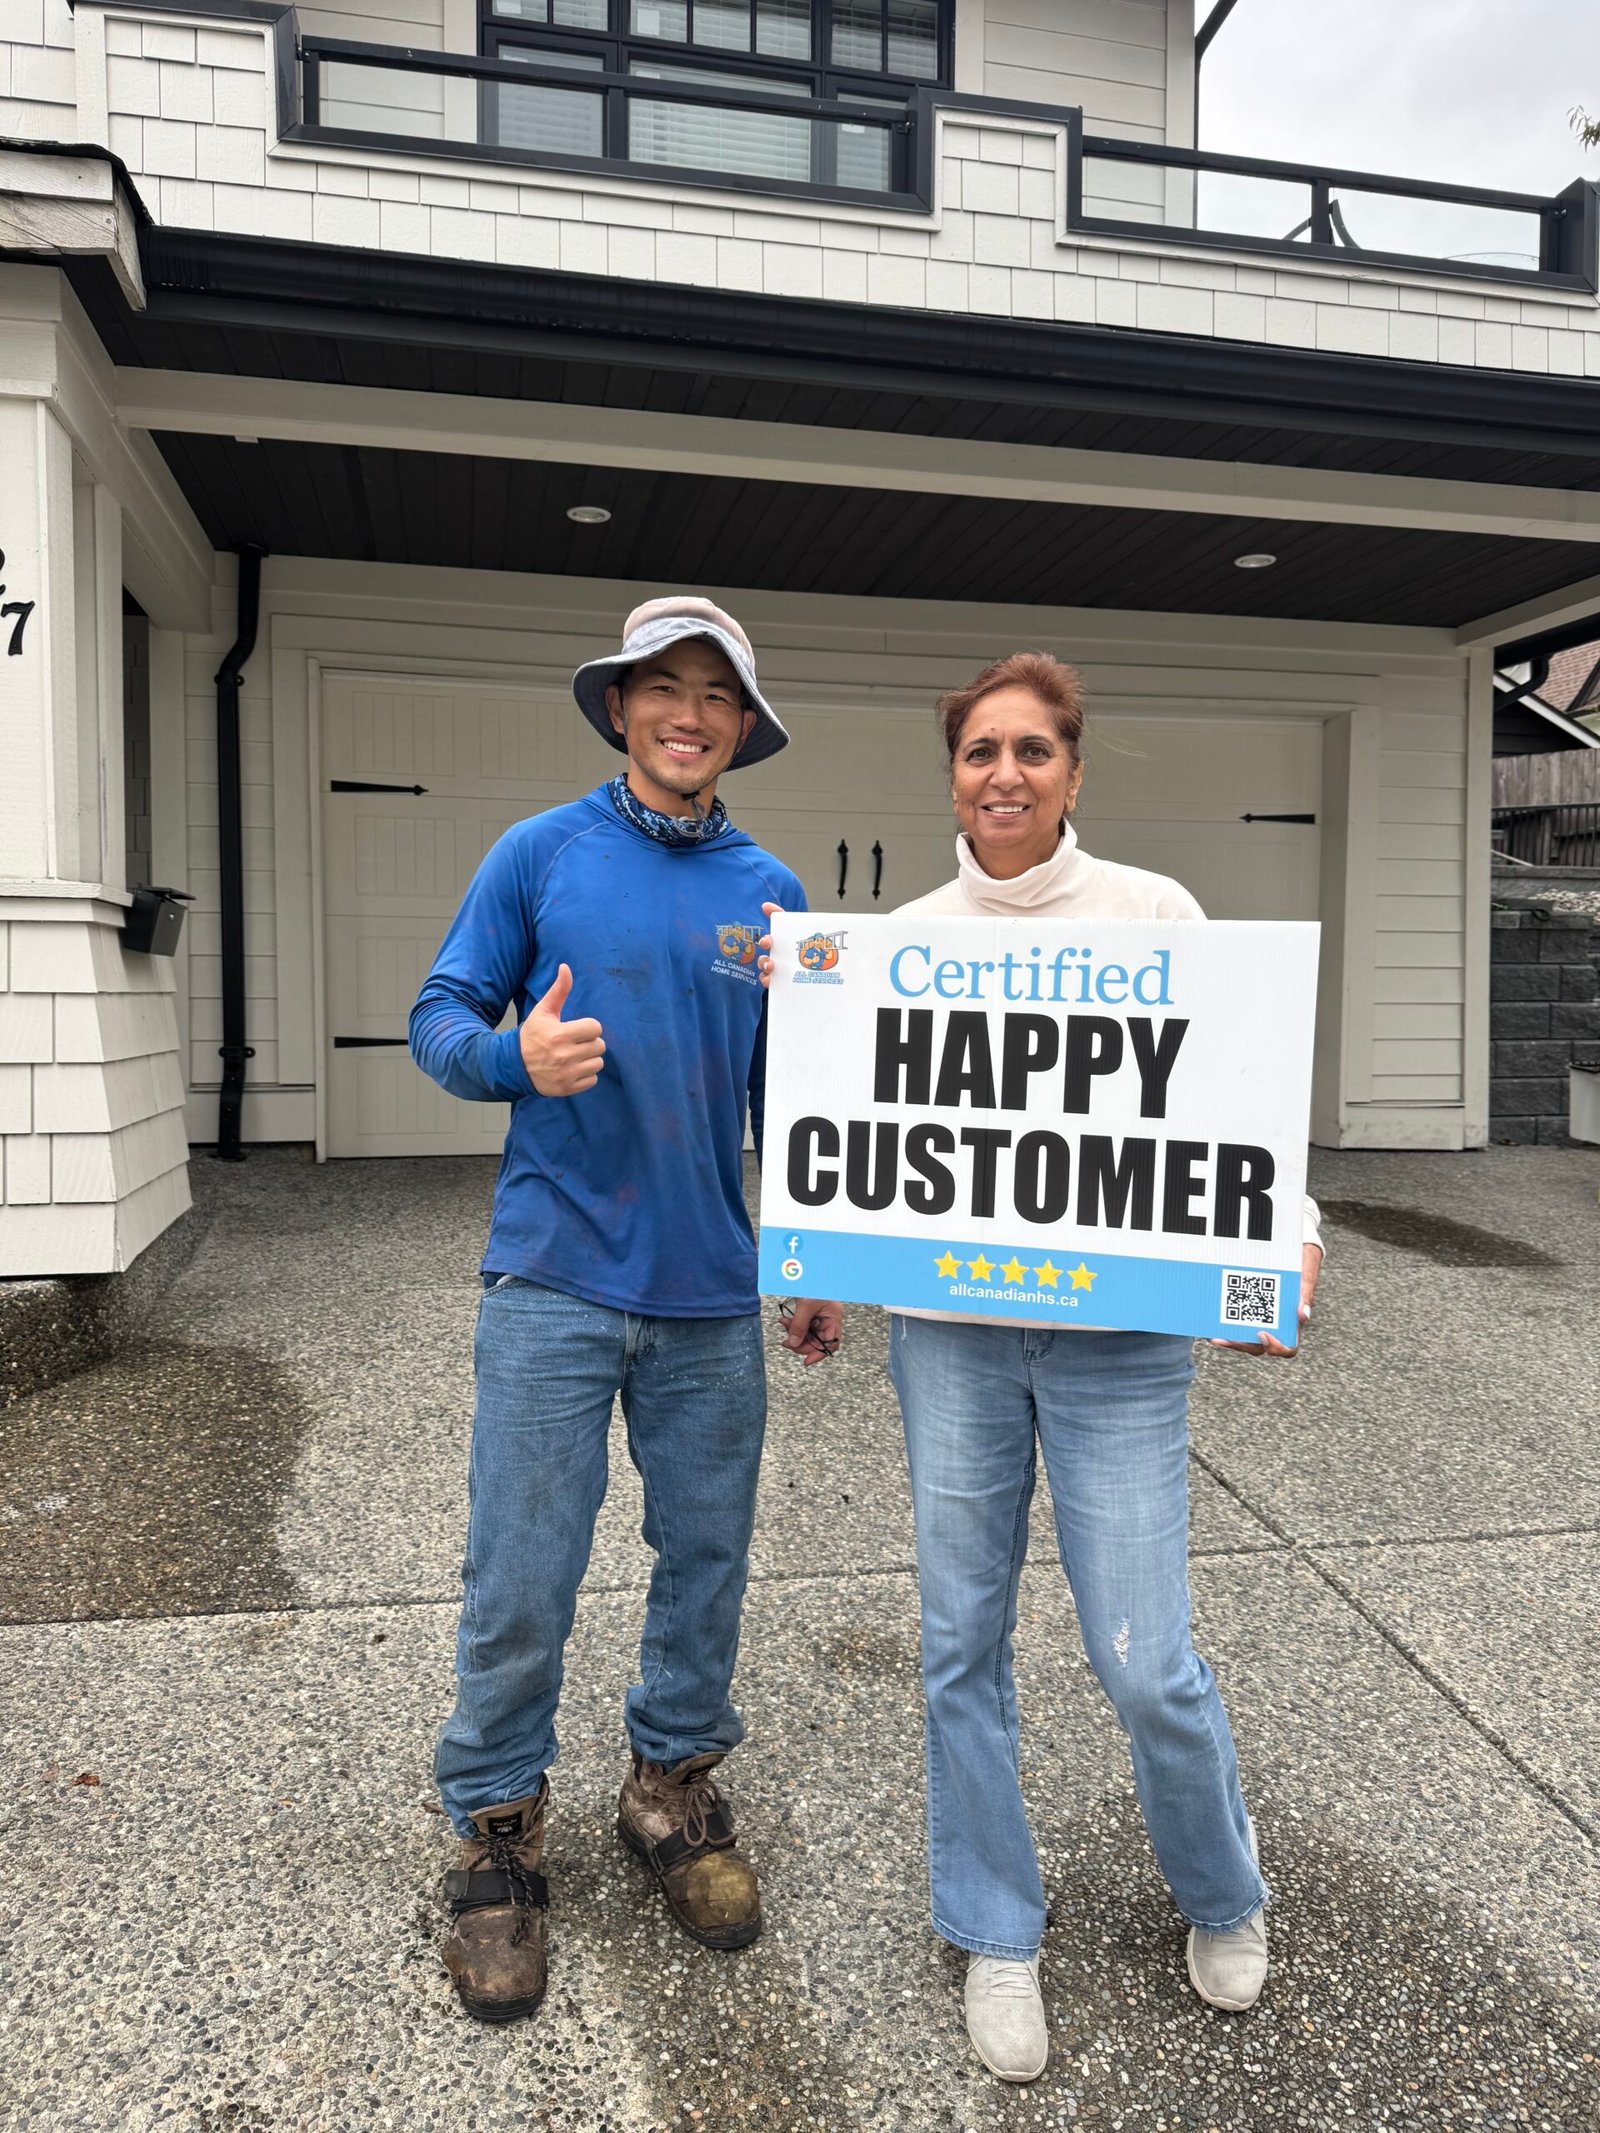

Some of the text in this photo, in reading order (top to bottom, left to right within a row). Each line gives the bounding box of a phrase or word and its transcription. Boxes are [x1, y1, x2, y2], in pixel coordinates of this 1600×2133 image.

[0, 600, 35, 656] 7
[710, 965, 758, 986] HOME SERVICES
[713, 958, 756, 977] ALL CANADIAN
[808, 971, 841, 979] CANADIAN
[889, 946, 1174, 1005] Certified
[791, 976, 844, 986] HOME SERVICES
[873, 1008, 1189, 1118] HAPPY
[787, 1117, 1275, 1242] CUSTOMER
[949, 1283, 1079, 1307] allcanadianhs.ca
